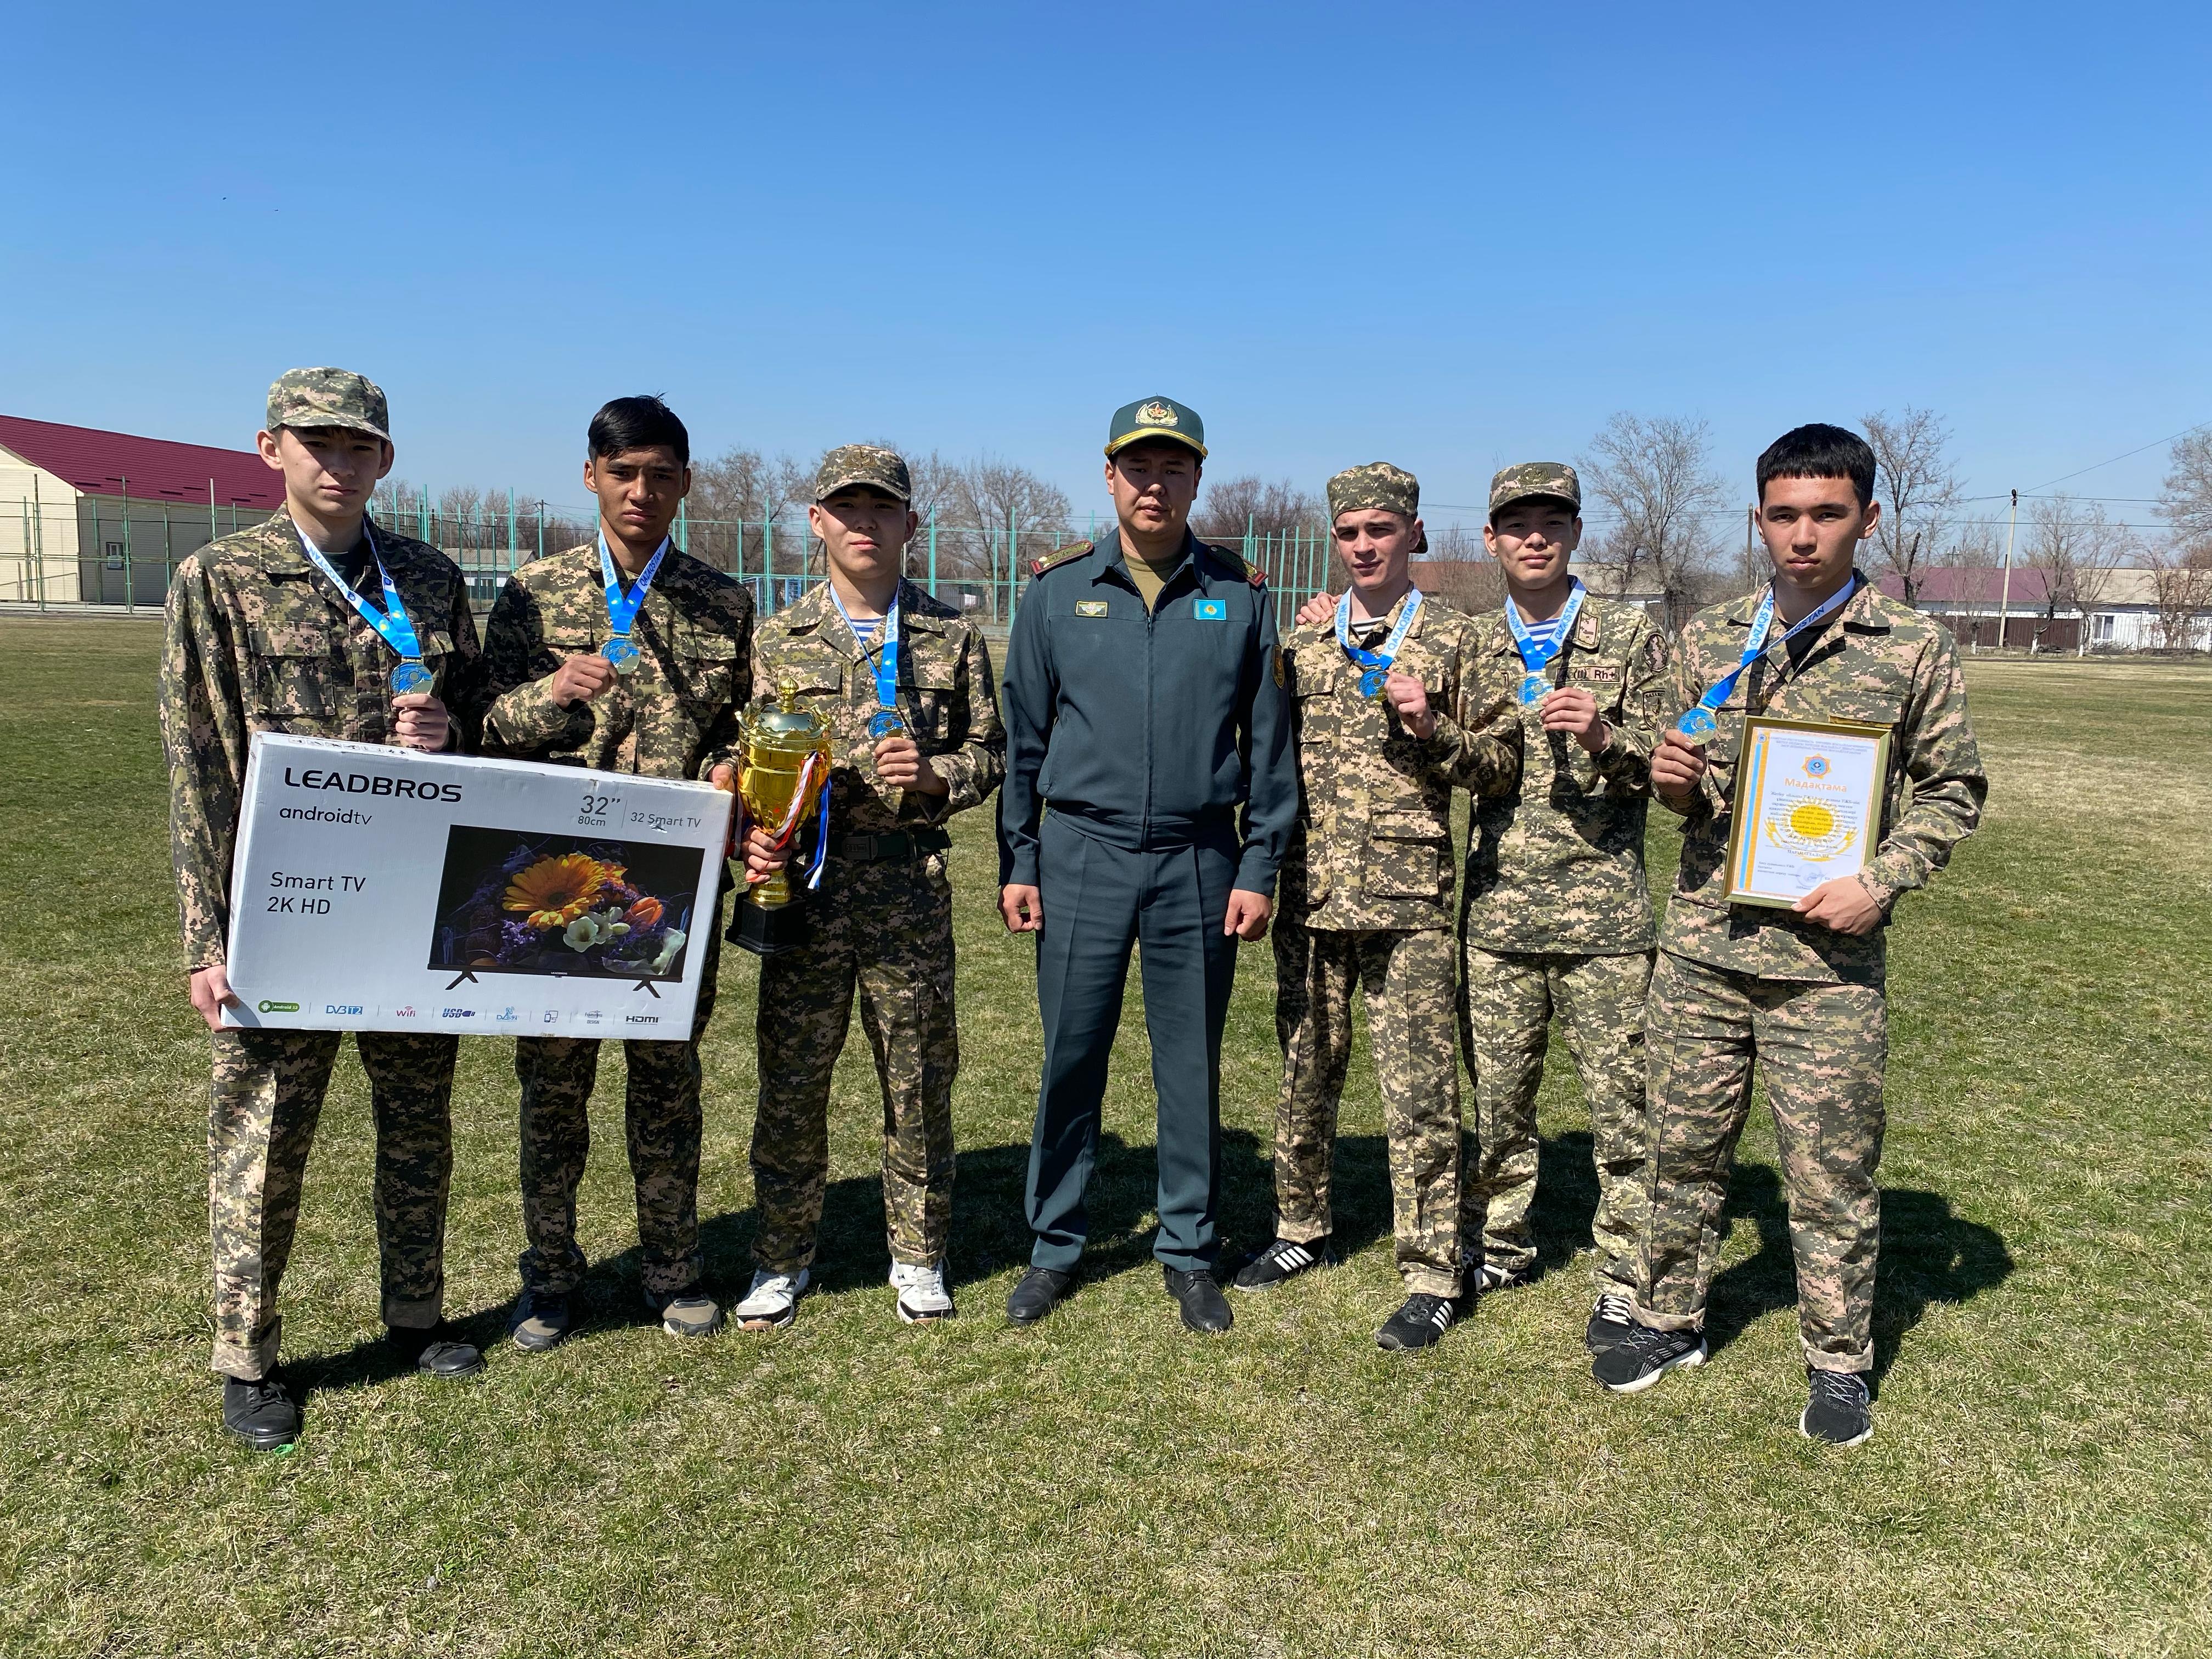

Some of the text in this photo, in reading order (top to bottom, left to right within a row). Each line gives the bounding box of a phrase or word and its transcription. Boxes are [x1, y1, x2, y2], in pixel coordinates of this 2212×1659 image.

[640, 549, 662, 587] QAZAQSTAN
[1387, 601, 1415, 651] QAZAQSTAN
[1555, 598, 1578, 640] QAZAQSTAN
[1750, 594, 1774, 646] QAZAQSTAN
[1594, 669, 1615, 679] Rh+
[284, 767, 462, 803] LEADBROS
[1784, 777, 1847, 792] Мадақтама
[578, 815, 606, 827] 80cm
[630, 812, 702, 828] 32 Smart TV
[270, 871, 366, 892] Smart TV
[267, 896, 330, 915] 2K HD
[442, 1008, 462, 1018] USB
